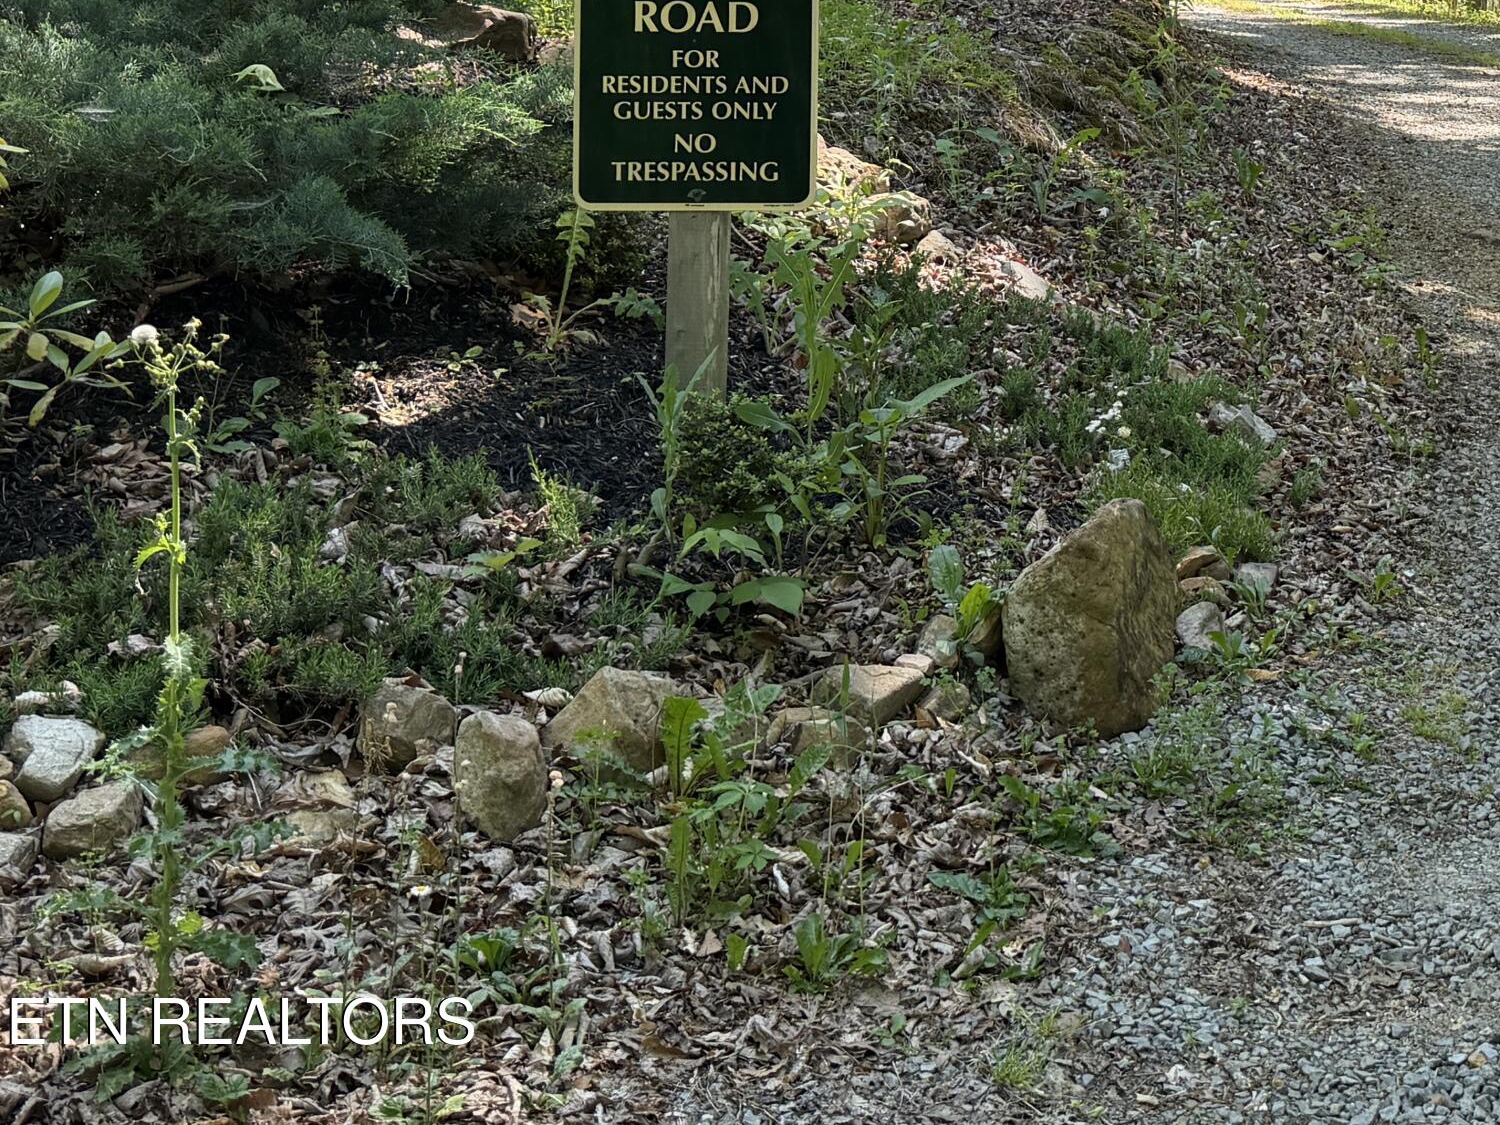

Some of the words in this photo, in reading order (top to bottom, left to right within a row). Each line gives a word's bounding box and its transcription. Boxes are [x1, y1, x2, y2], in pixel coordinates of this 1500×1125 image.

[633, 0, 760, 33] ROAD
[671, 49, 720, 68] FOR
[602, 75, 727, 94] RESIDENTS
[734, 75, 789, 94] AND
[613, 101, 703, 120] GUESTS
[711, 101, 777, 120] ONLY
[674, 133, 716, 153] NO
[611, 161, 779, 182] TRESPASSING
